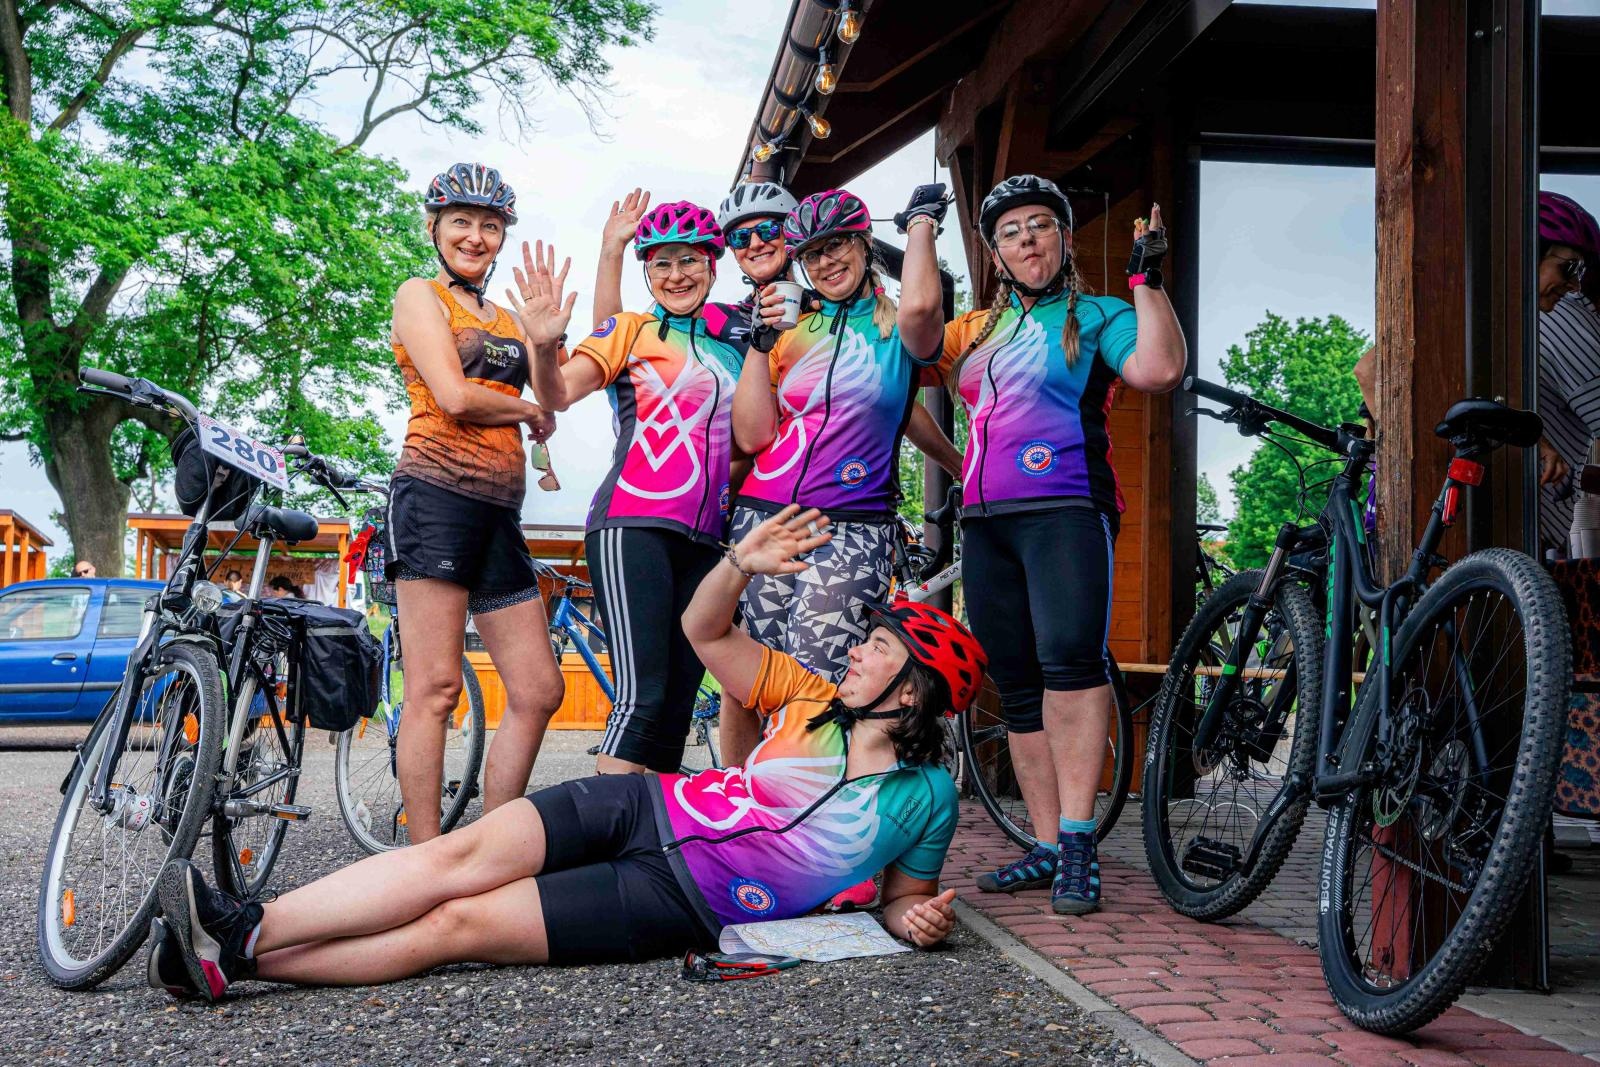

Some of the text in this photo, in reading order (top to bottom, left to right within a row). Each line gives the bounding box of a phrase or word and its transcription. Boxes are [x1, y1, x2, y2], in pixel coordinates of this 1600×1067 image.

[211, 426, 277, 473] 280
[1149, 672, 1175, 753] BONTRAGER
[1321, 804, 1340, 900] BONTRAGER
